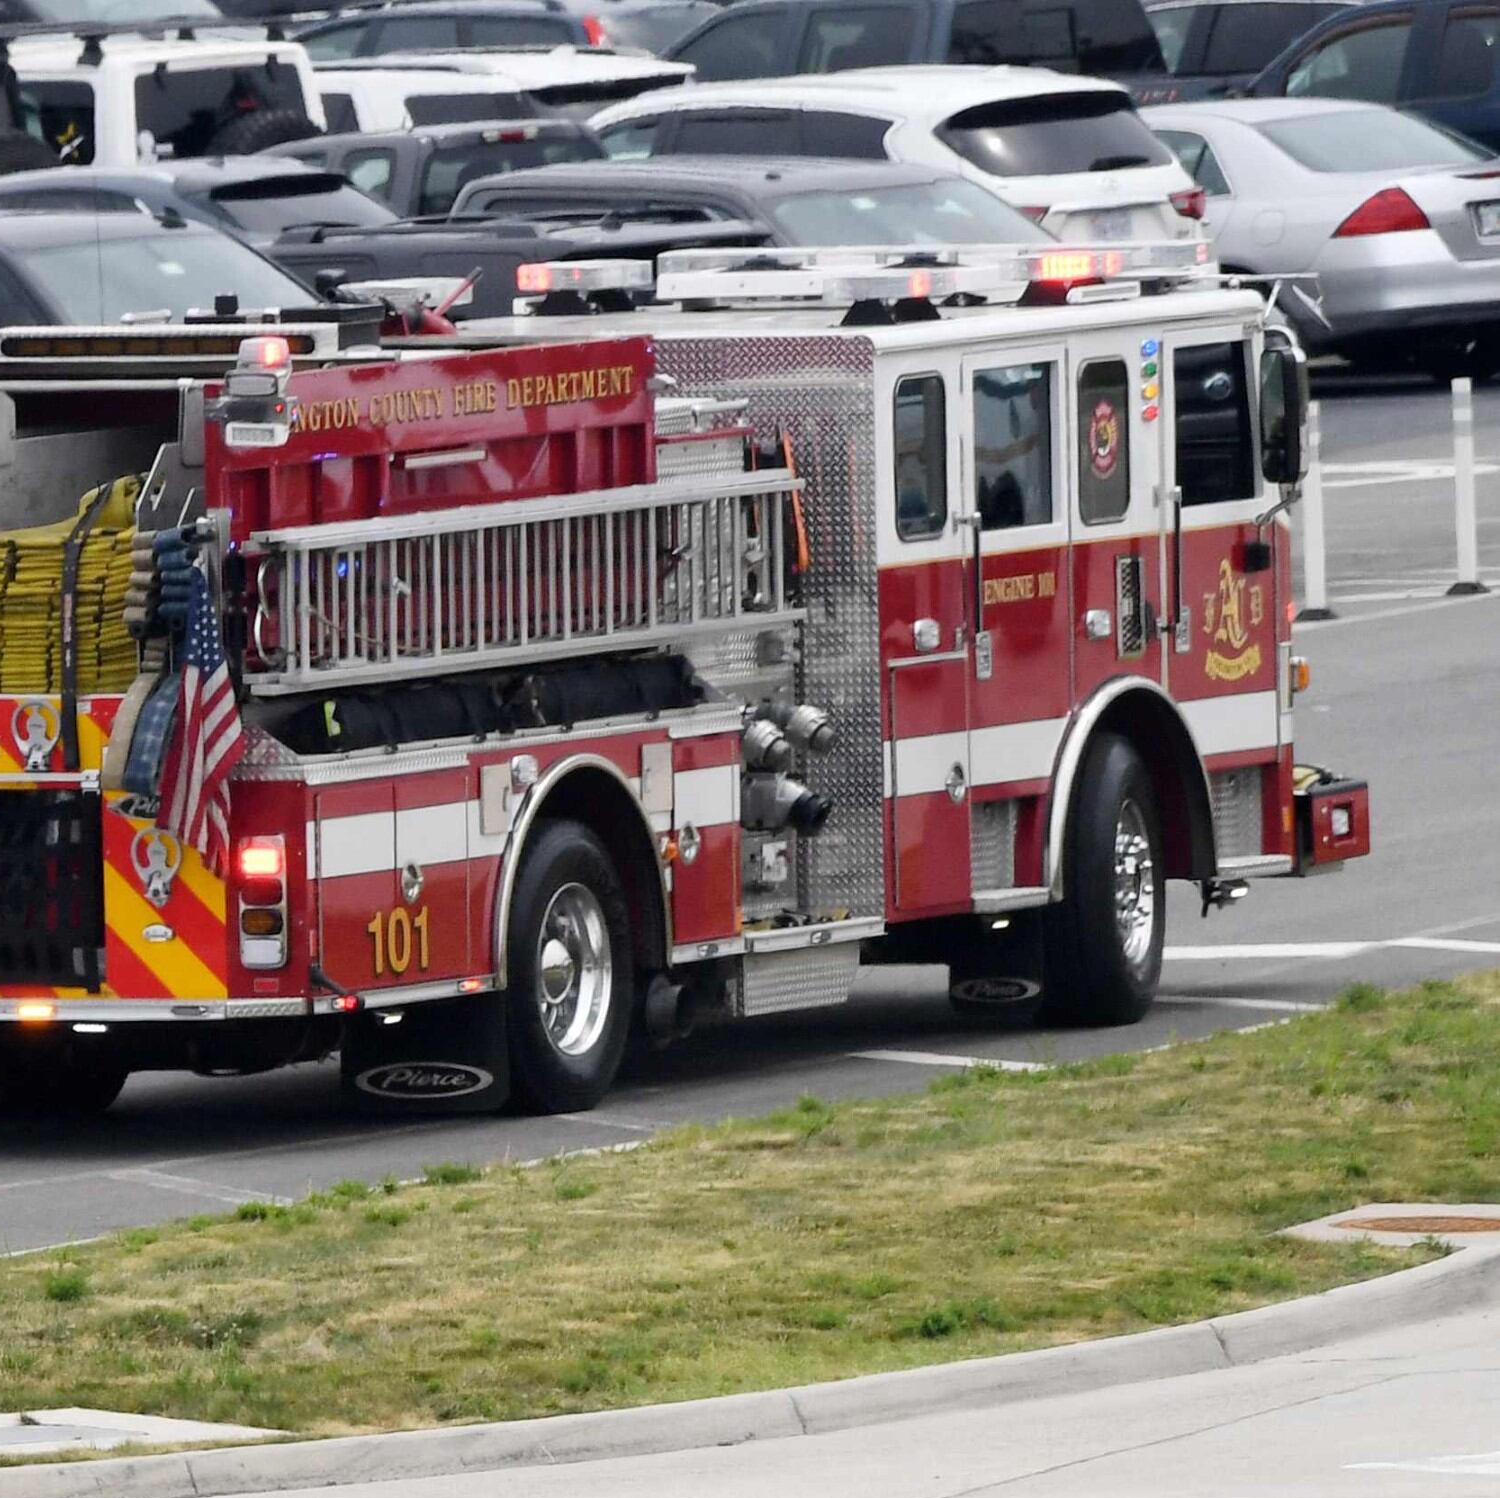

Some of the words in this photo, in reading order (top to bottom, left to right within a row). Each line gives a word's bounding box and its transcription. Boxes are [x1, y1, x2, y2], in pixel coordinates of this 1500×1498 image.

[369, 386, 443, 425] COUNTY
[453, 382, 497, 415] FIRE
[506, 366, 634, 410] DEPARTMENT
[367, 906, 430, 974] 101
[381, 1067, 473, 1089] Pierce
